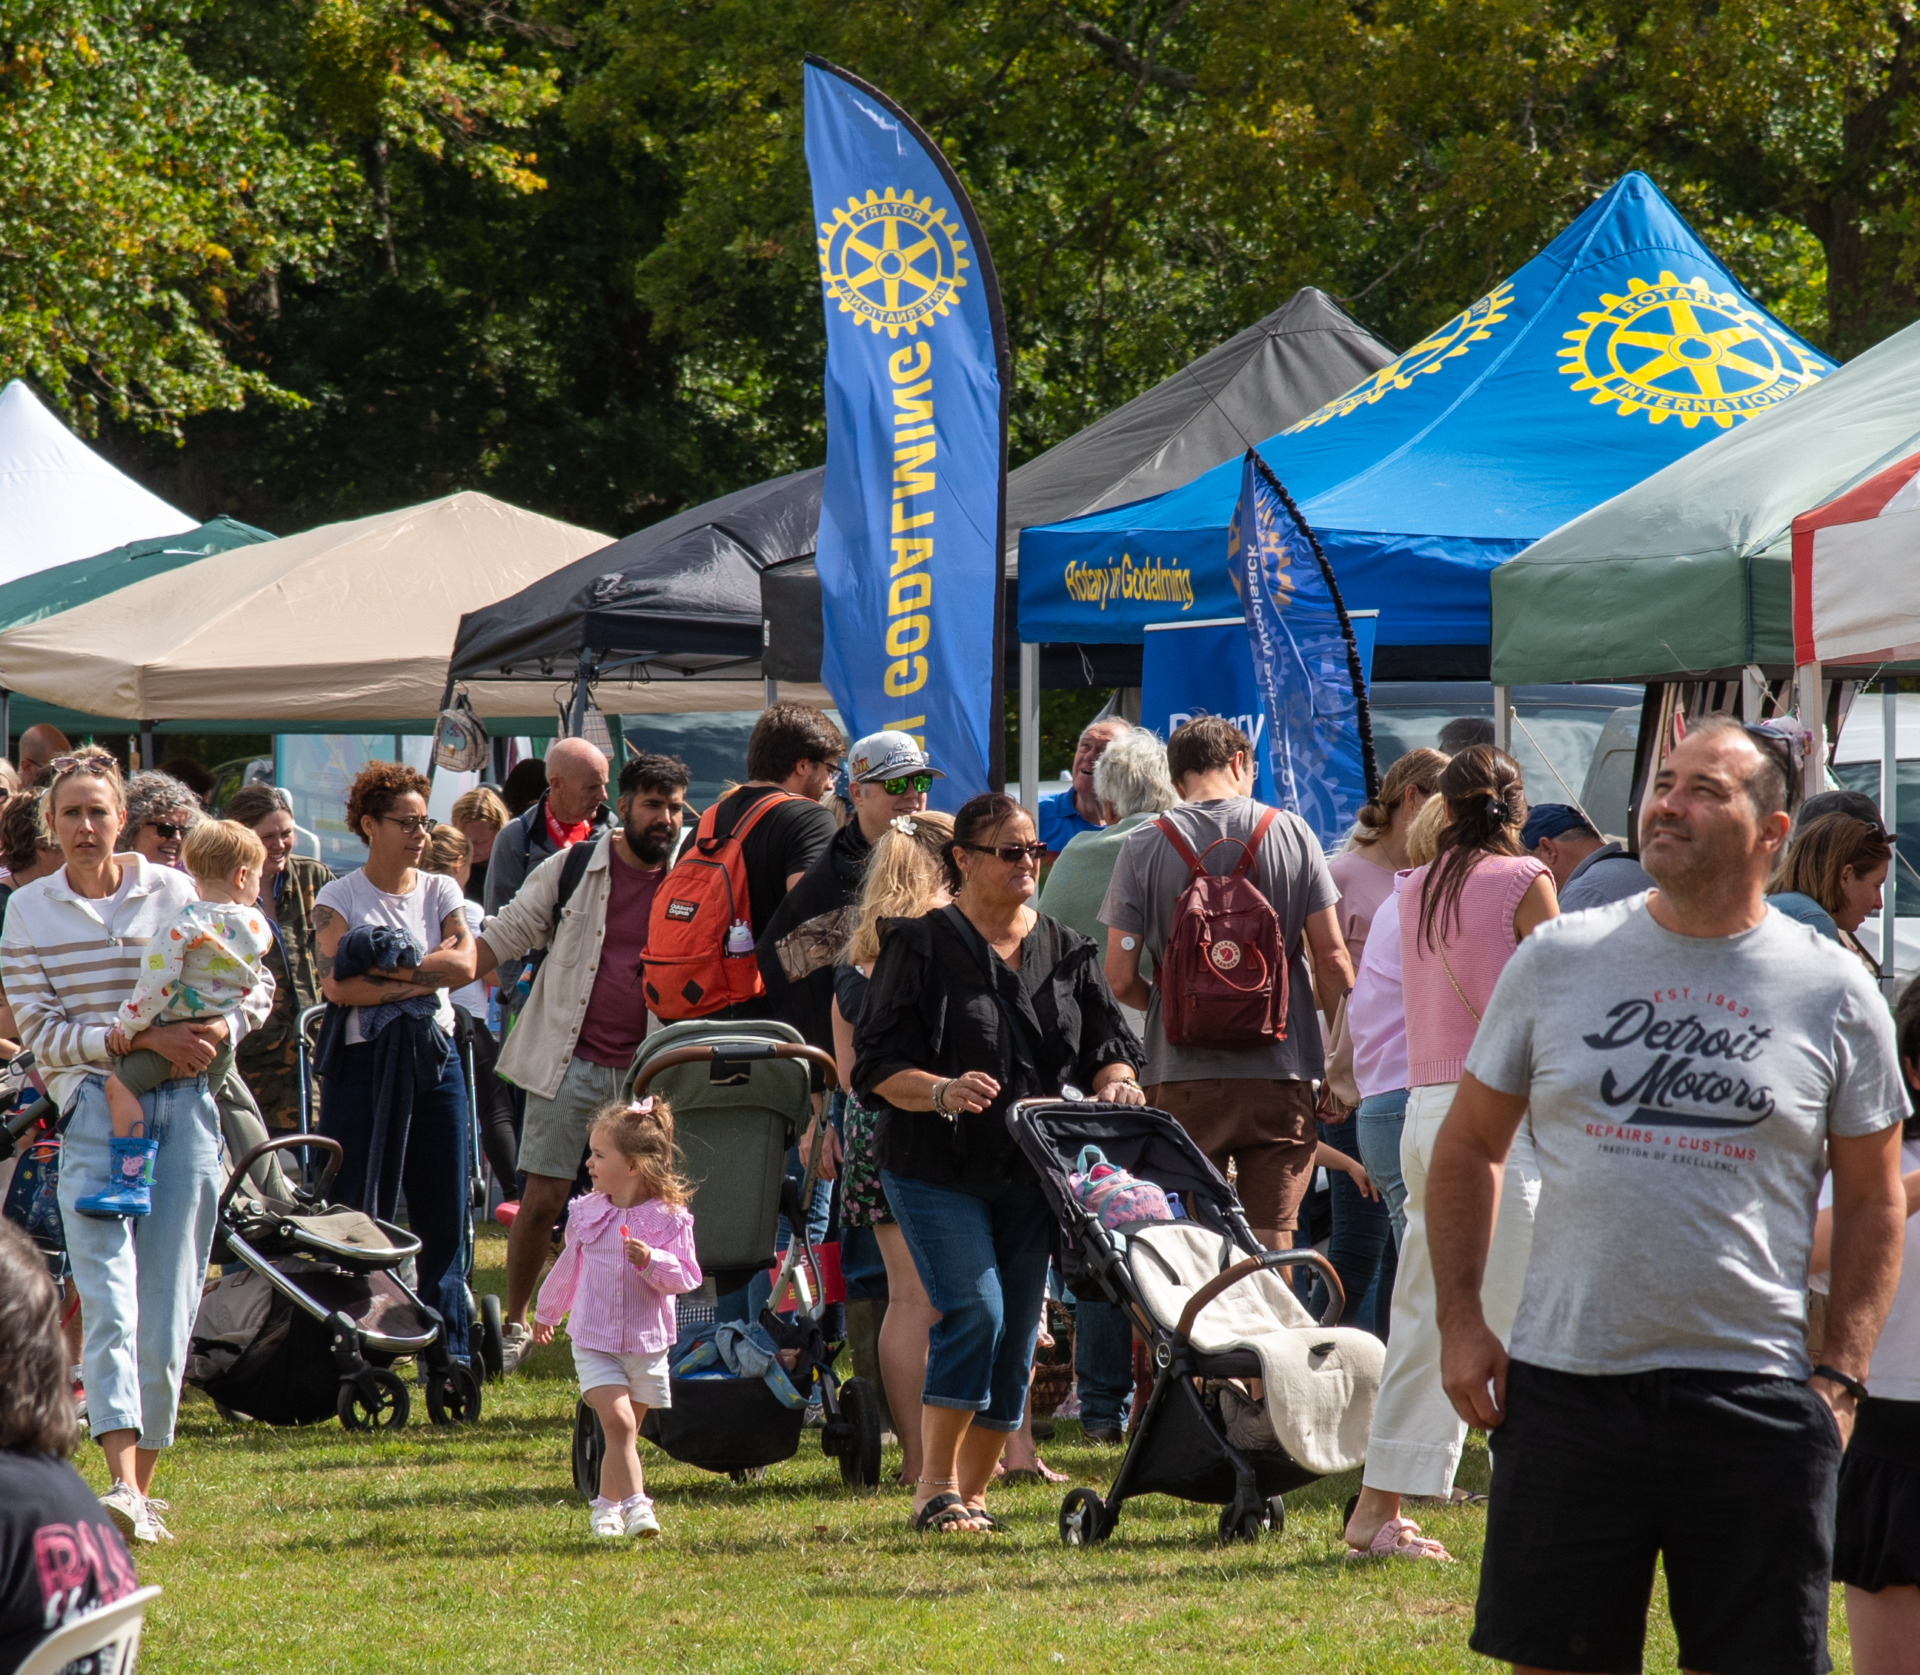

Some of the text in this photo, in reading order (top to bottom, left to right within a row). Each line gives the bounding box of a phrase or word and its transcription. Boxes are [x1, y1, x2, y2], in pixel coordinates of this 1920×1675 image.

[1620, 286, 1730, 314] ROTARY
[1614, 380, 1799, 413] INTERNATIONAL
[1065, 553, 1194, 611] Rotary in Godalming
[1654, 987, 1750, 1018] EST. 1963
[1582, 998, 1773, 1062] Detroit
[1600, 1053, 1775, 1114] Motors
[1585, 1123, 1653, 1144] REPAIRS
[1678, 1135, 1757, 1162] CUSTOMS
[1598, 1143, 1739, 1174] TRADITION OF EXCELLENCE
